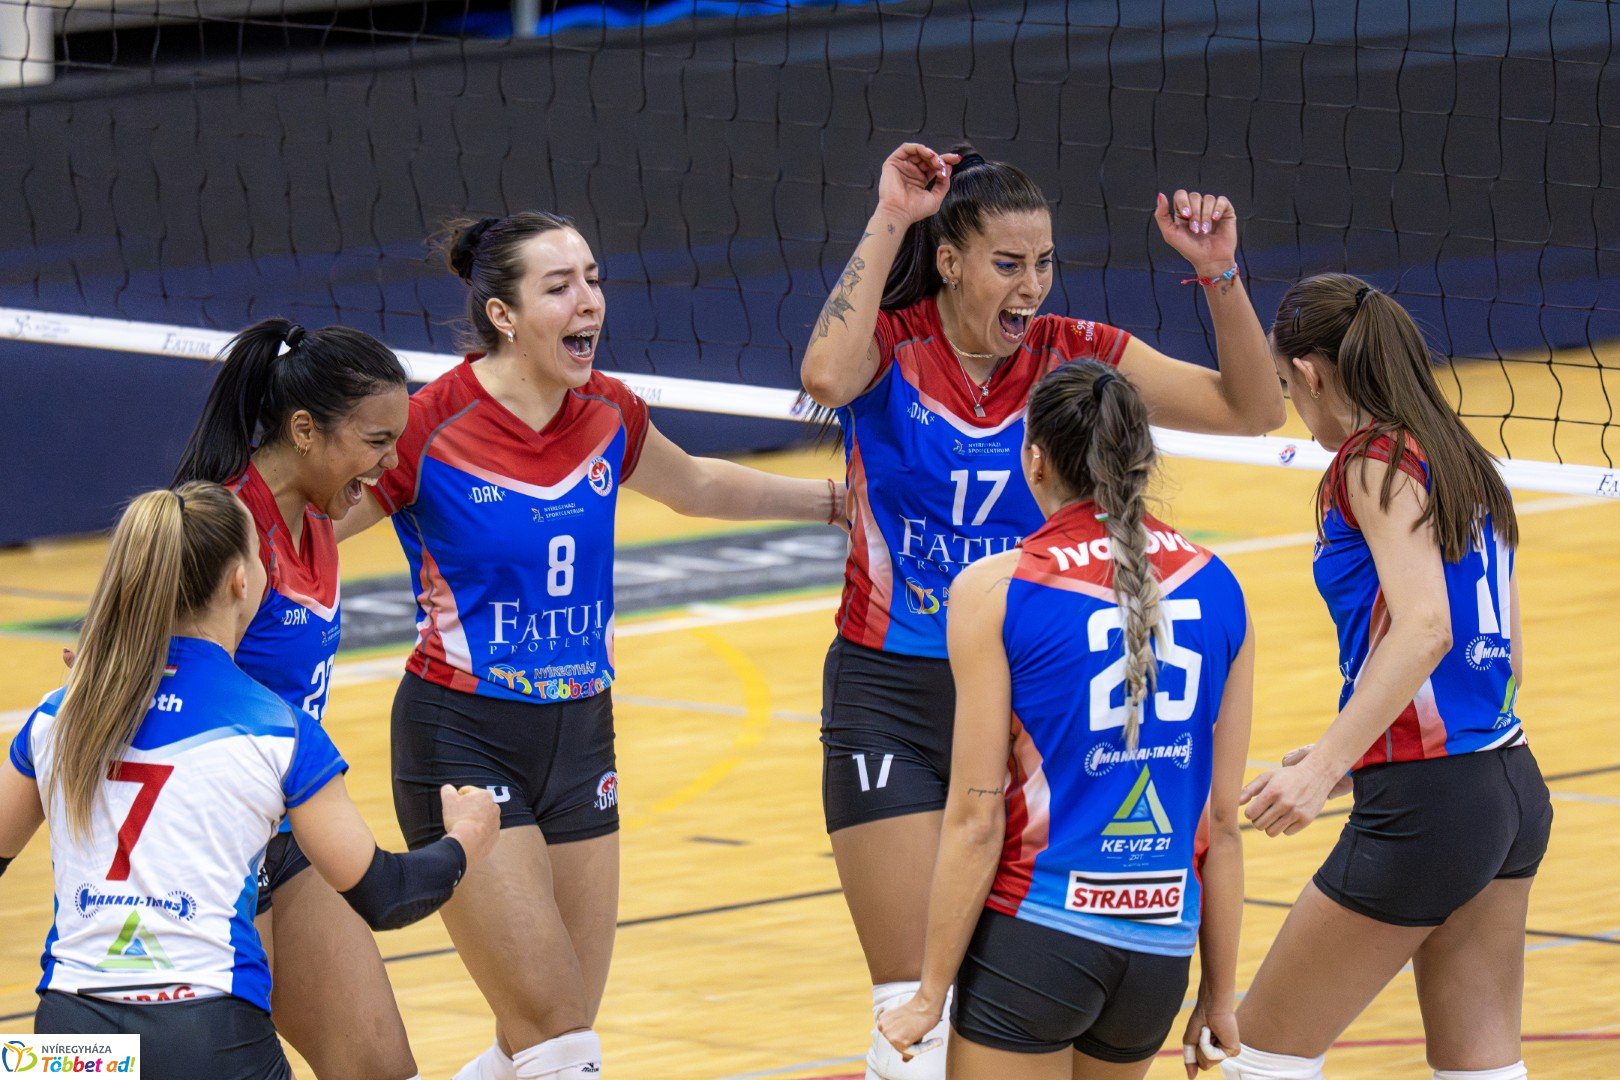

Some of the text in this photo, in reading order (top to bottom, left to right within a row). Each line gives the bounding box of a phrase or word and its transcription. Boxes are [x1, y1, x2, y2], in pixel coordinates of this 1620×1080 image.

[950, 469, 1011, 526] 17
[547, 534, 576, 597] 8
[533, 661, 597, 679] NYÍREGYHÁZ
[1087, 598, 1203, 731] 25
[105, 760, 175, 881] 7
[1101, 837, 1171, 853] KE-VIZ 21
[1072, 886, 1180, 909] STRABAG
